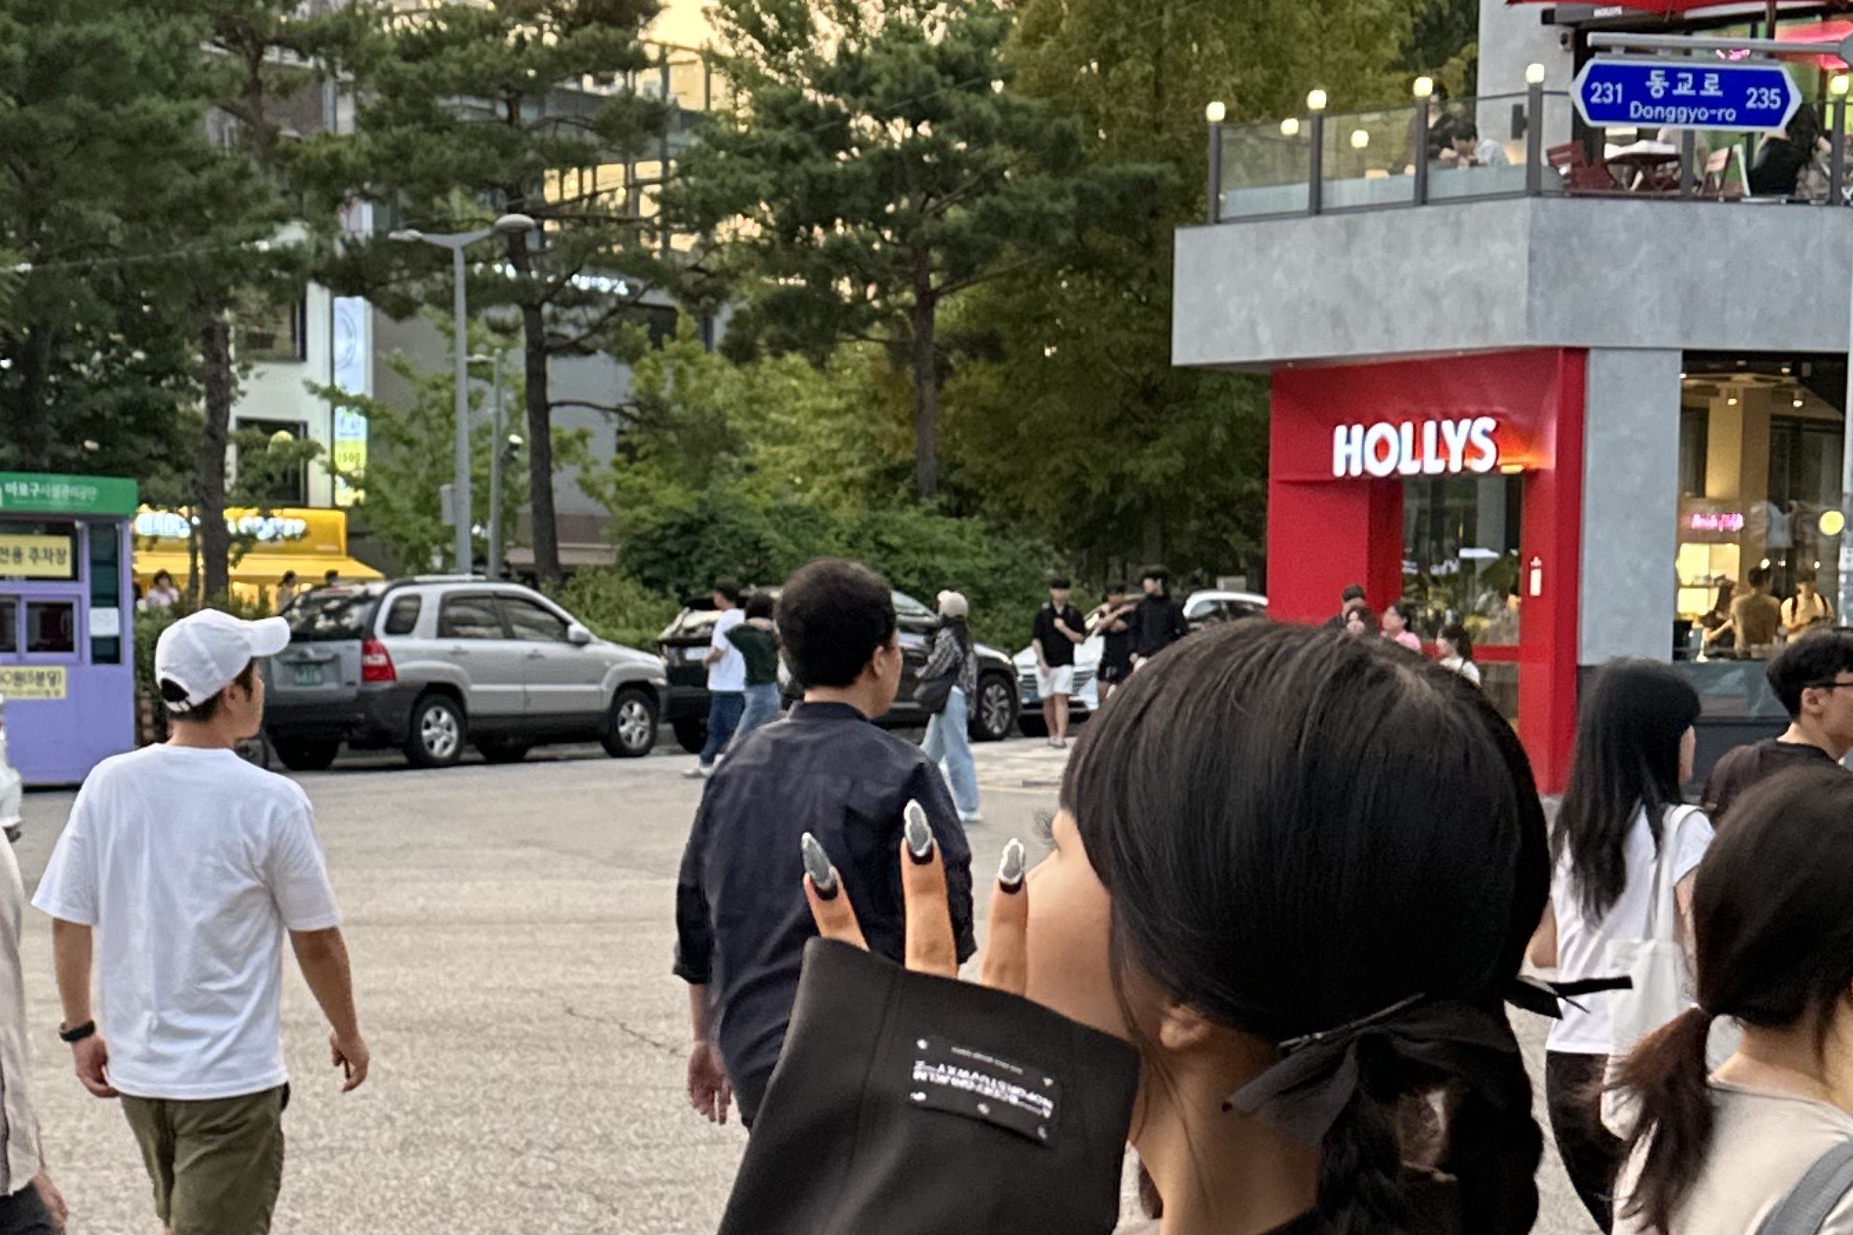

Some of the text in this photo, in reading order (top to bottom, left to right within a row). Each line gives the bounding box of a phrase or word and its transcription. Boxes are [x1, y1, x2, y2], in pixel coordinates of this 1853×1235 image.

[1590, 82, 1623, 104] 231
[1645, 70, 1723, 99] 동교로
[1745, 87, 1782, 110] 235
[1629, 101, 1737, 124] Donggyo-ro
[1333, 416, 1498, 477] HOLLYS
[25, 545, 67, 567] 주차장
